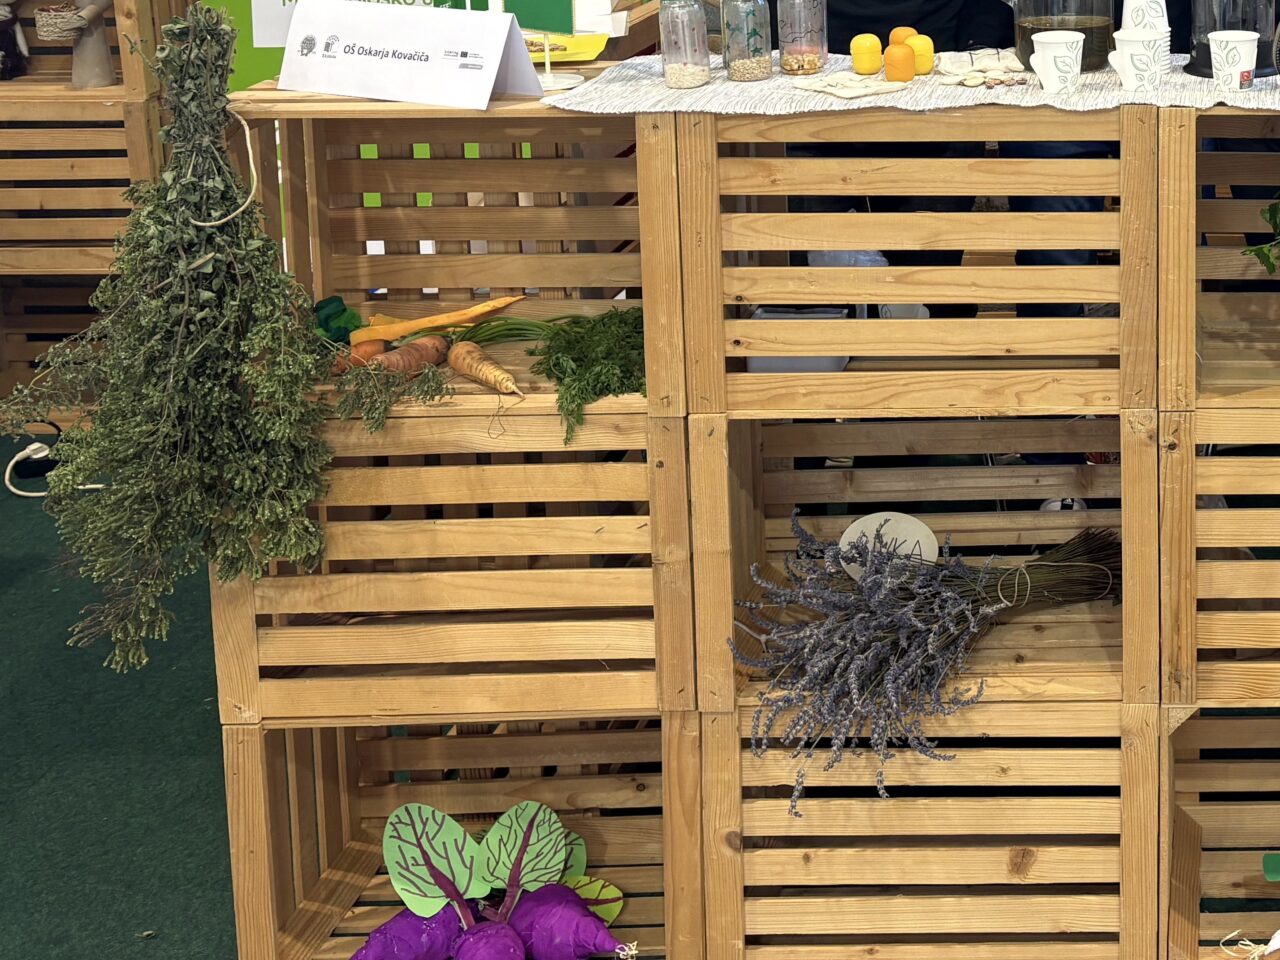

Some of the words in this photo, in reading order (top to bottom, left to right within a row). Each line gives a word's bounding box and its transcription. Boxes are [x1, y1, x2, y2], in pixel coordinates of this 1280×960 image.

[343, 43, 356, 55] OŠ
[357, 47, 390, 60] Oskarja
[391, 49, 429, 63] Kovačiča
